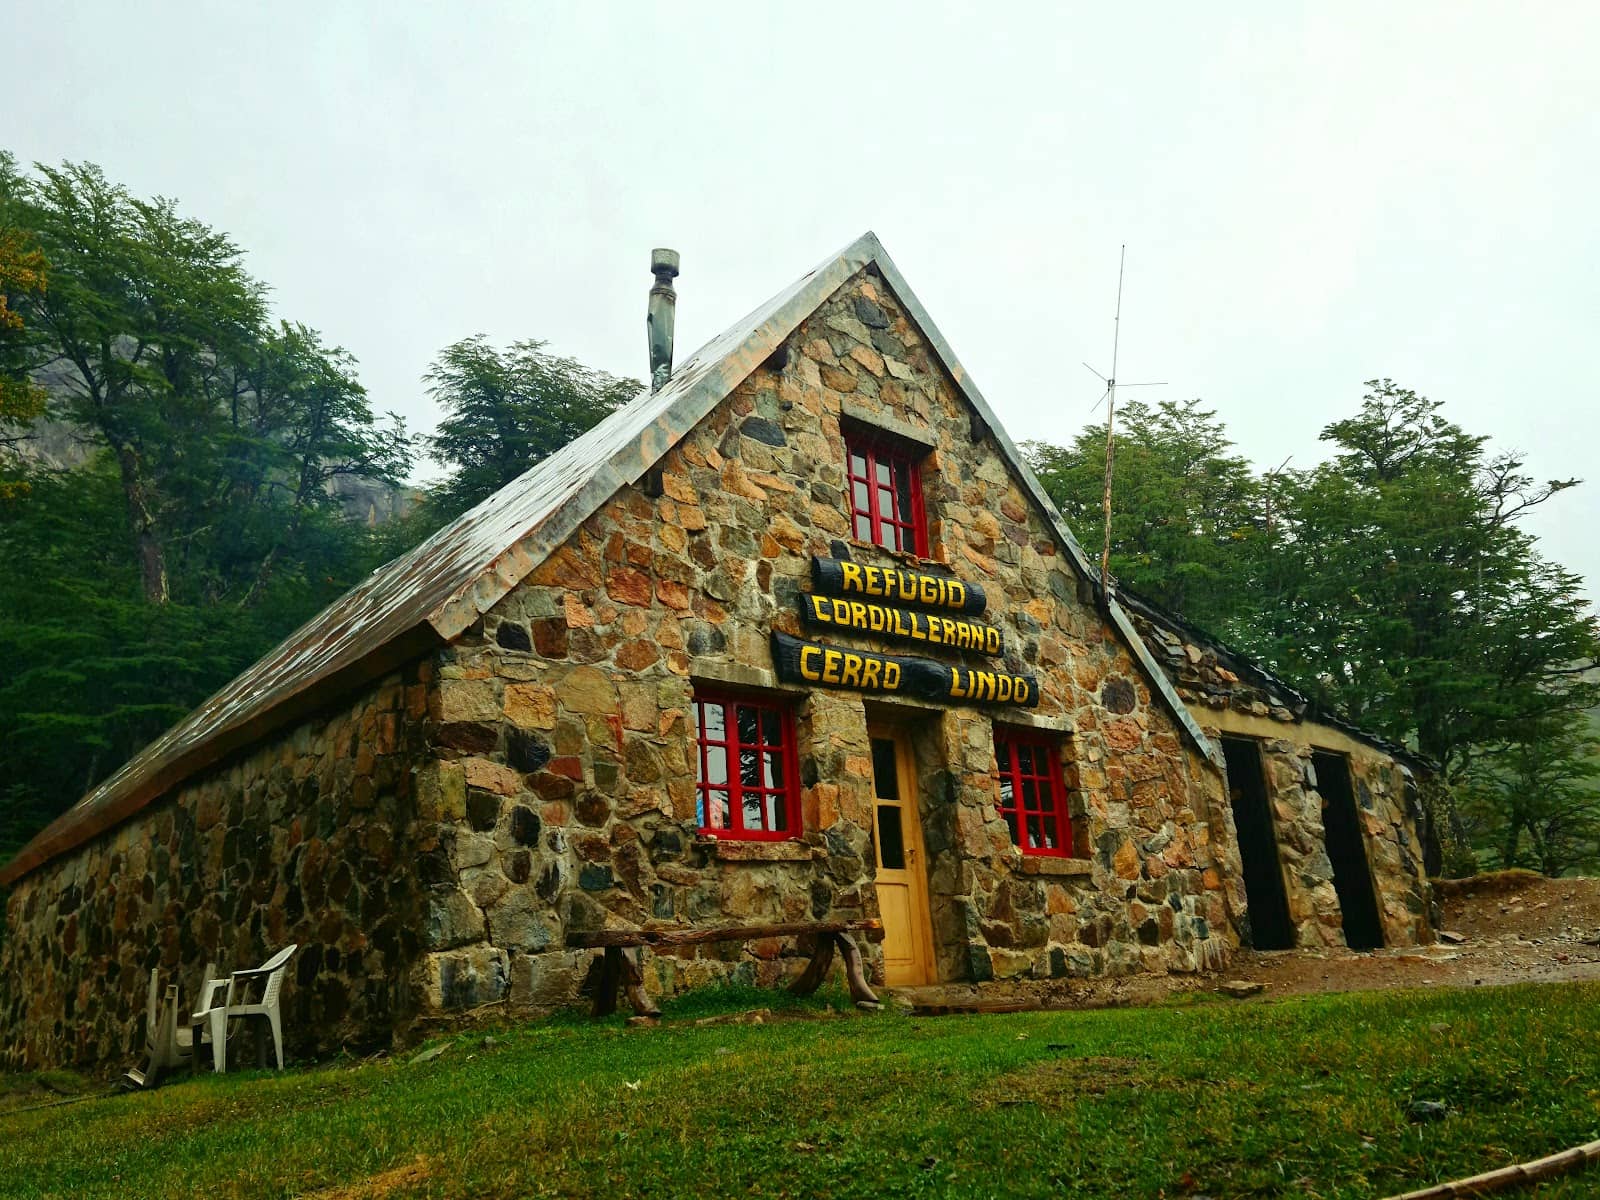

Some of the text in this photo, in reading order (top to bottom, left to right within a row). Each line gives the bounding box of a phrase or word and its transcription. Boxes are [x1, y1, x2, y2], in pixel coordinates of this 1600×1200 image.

[840, 561, 966, 609] REFUGIO
[811, 595, 1000, 654] CORDILLERANO
[800, 645, 1029, 704] CERRO LINDO
